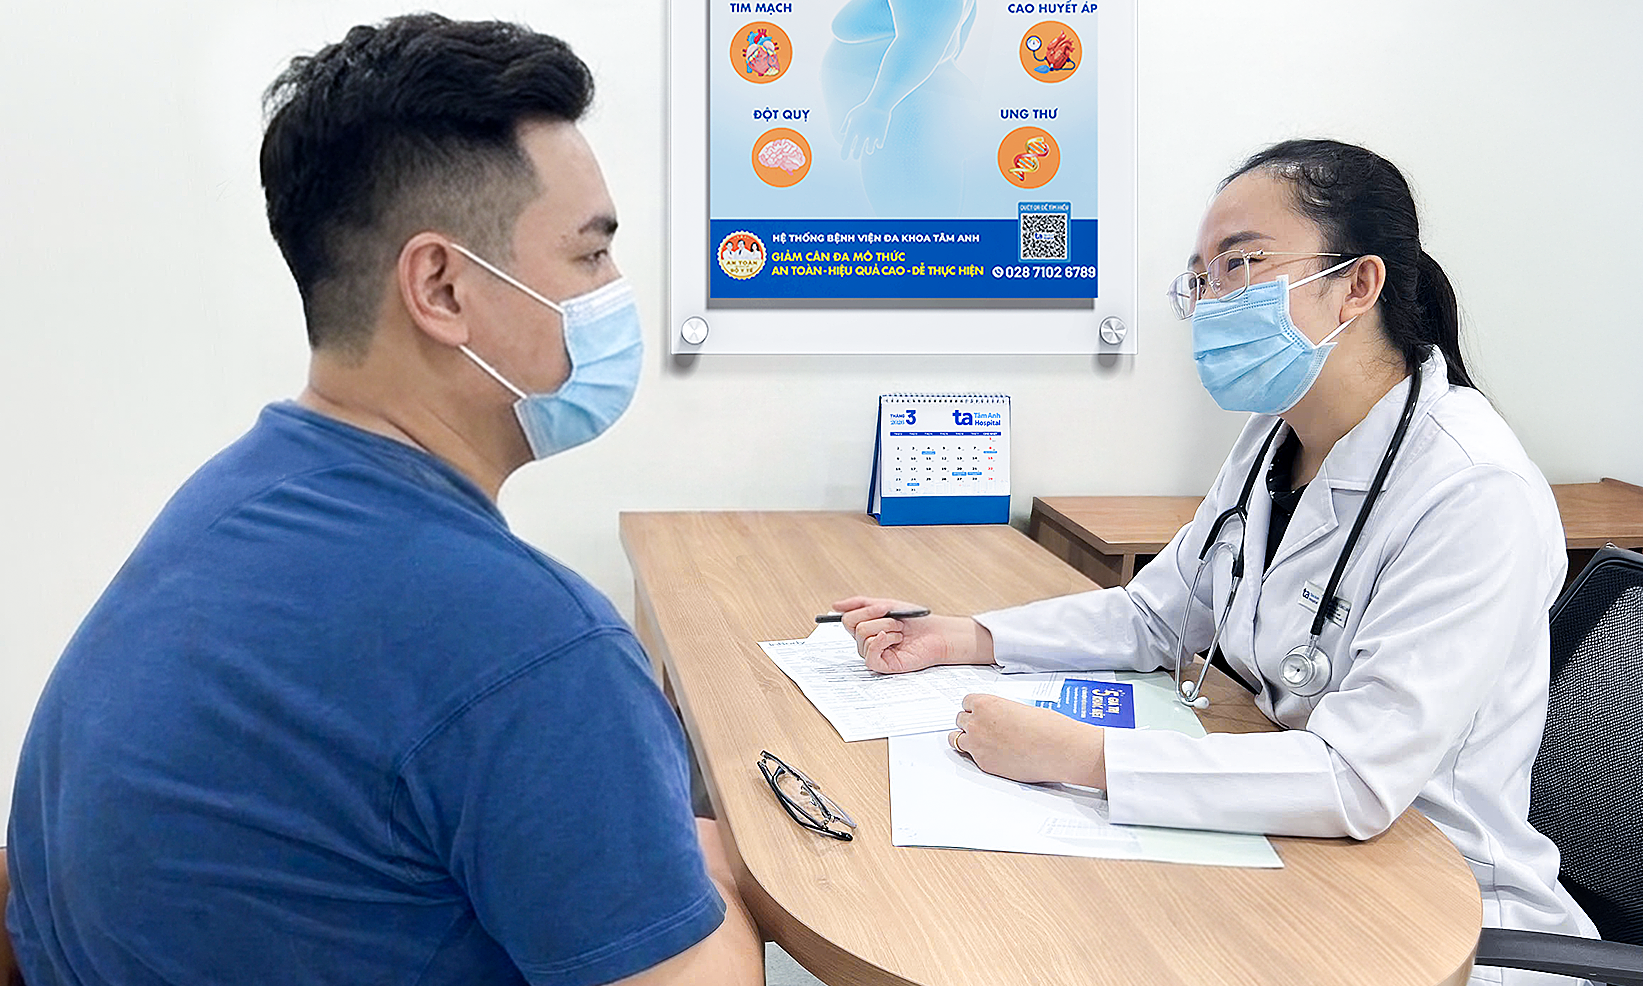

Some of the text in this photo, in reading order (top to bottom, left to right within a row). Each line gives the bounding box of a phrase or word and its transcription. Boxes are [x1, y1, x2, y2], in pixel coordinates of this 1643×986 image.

[730, 3, 792, 16] TIM MẠCH
[1008, 4, 1034, 13] CAO
[1039, 0, 1077, 13] HUYẾT
[753, 107, 810, 122] ĐỘT QUỴ
[1001, 108, 1058, 119] UNG THƯ
[773, 233, 787, 244] HỆ
[789, 231, 824, 242] THỐNG
[827, 233, 855, 244] BỆNH
[858, 233, 881, 244] VIỆN
[902, 235, 931, 243] KHOA
[933, 233, 954, 242] TÂM
[957, 234, 980, 243] ANH
[772, 249, 905, 261] GIẢM CÂN ĐA MÔ THỨC
[772, 266, 789, 275] AN
[855, 263, 880, 276] QUẢ
[928, 265, 956, 277] THỰC
[959, 264, 984, 277] HIỆN
[1005, 266, 1096, 278] 028 7102 6789
[906, 410, 917, 425] 3
[952, 410, 973, 426] ta
